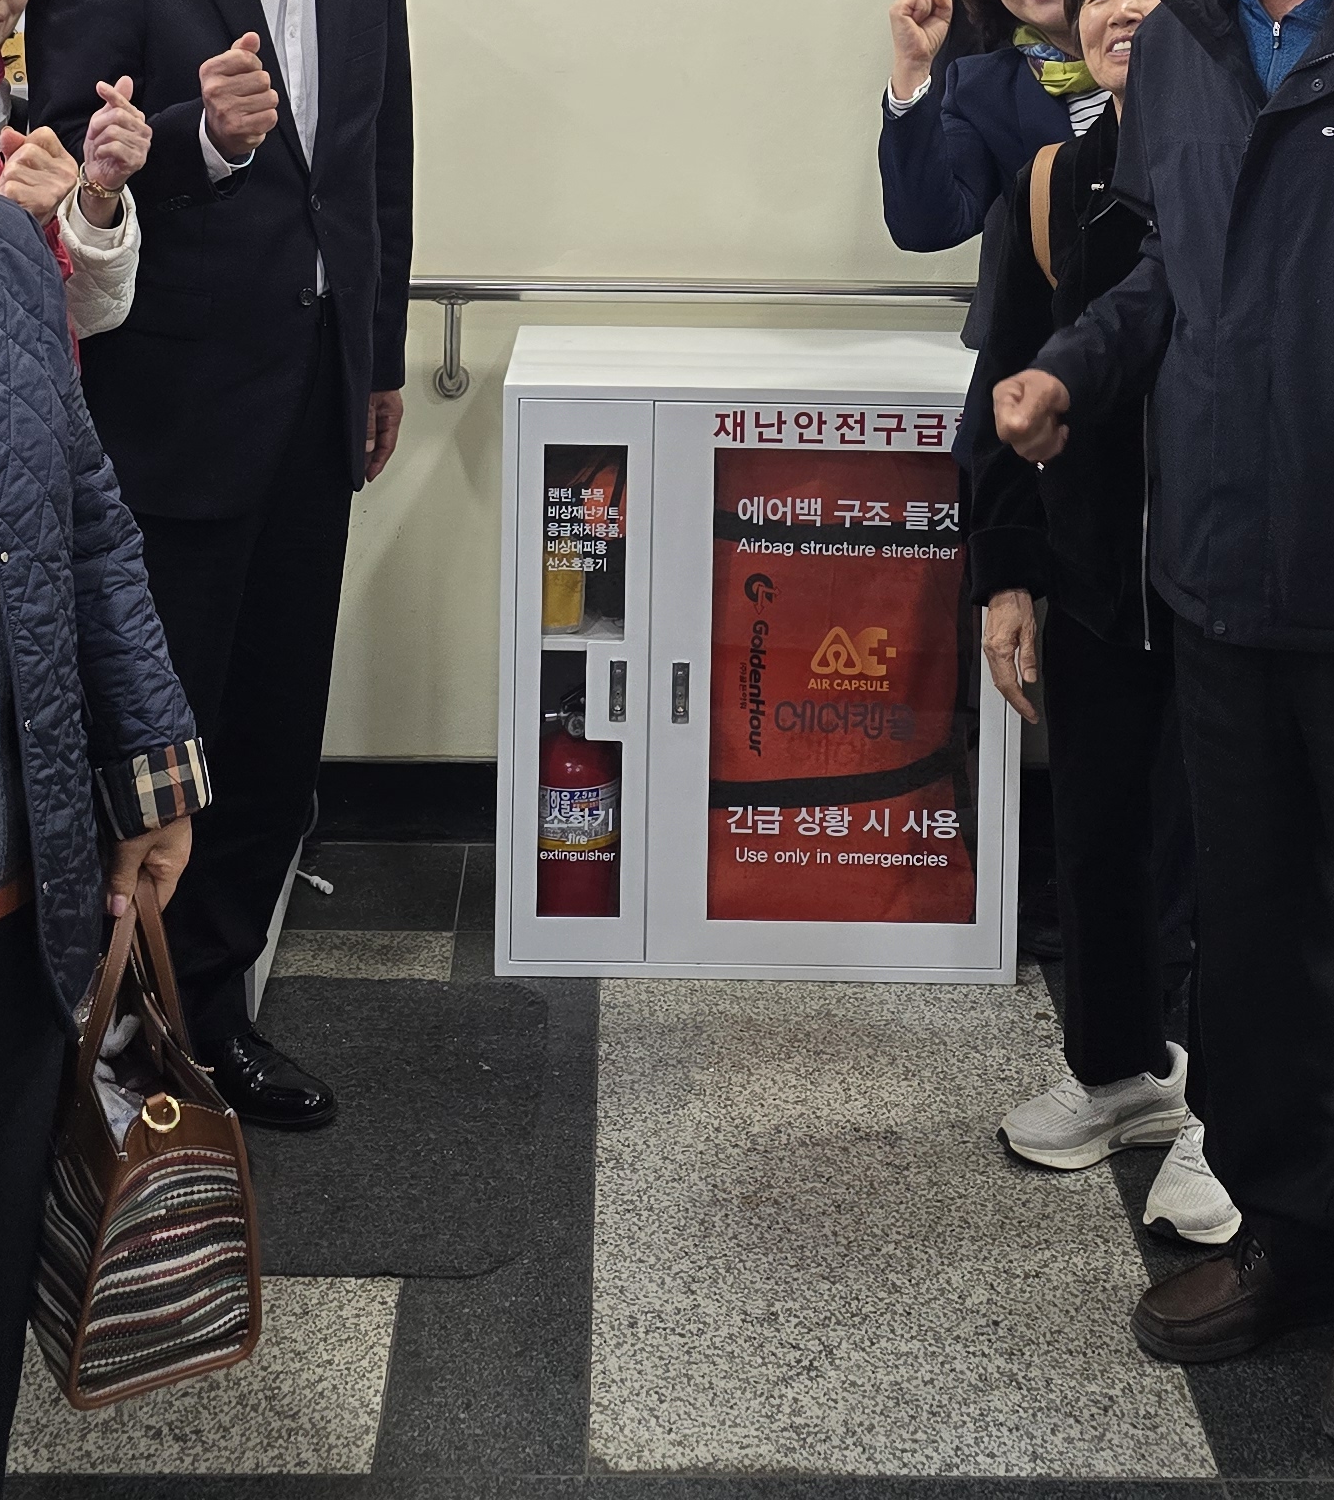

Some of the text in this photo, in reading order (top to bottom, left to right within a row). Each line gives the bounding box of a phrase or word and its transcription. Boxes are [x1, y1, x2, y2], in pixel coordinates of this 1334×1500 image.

[713, 410, 964, 446] 재난안전구급
[579, 488, 605, 502] 부목
[547, 505, 623, 520] 비상재난키트,
[737, 496, 960, 532] 에어백 구조 들것
[547, 522, 623, 538] 응급처치용품,
[547, 540, 607, 554] 비상대피용
[737, 537, 958, 560] Airbag structure stretcher
[546, 557, 607, 572] 산소호흡기
[749, 619, 769, 757] GoldenHour
[807, 678, 890, 692] AIR CAPSULE
[544, 807, 613, 831] 소화기
[726, 806, 960, 839] 긴급 상황 시 사용
[540, 849, 615, 861] extinguisher
[735, 847, 948, 867] Use only in emergencies
